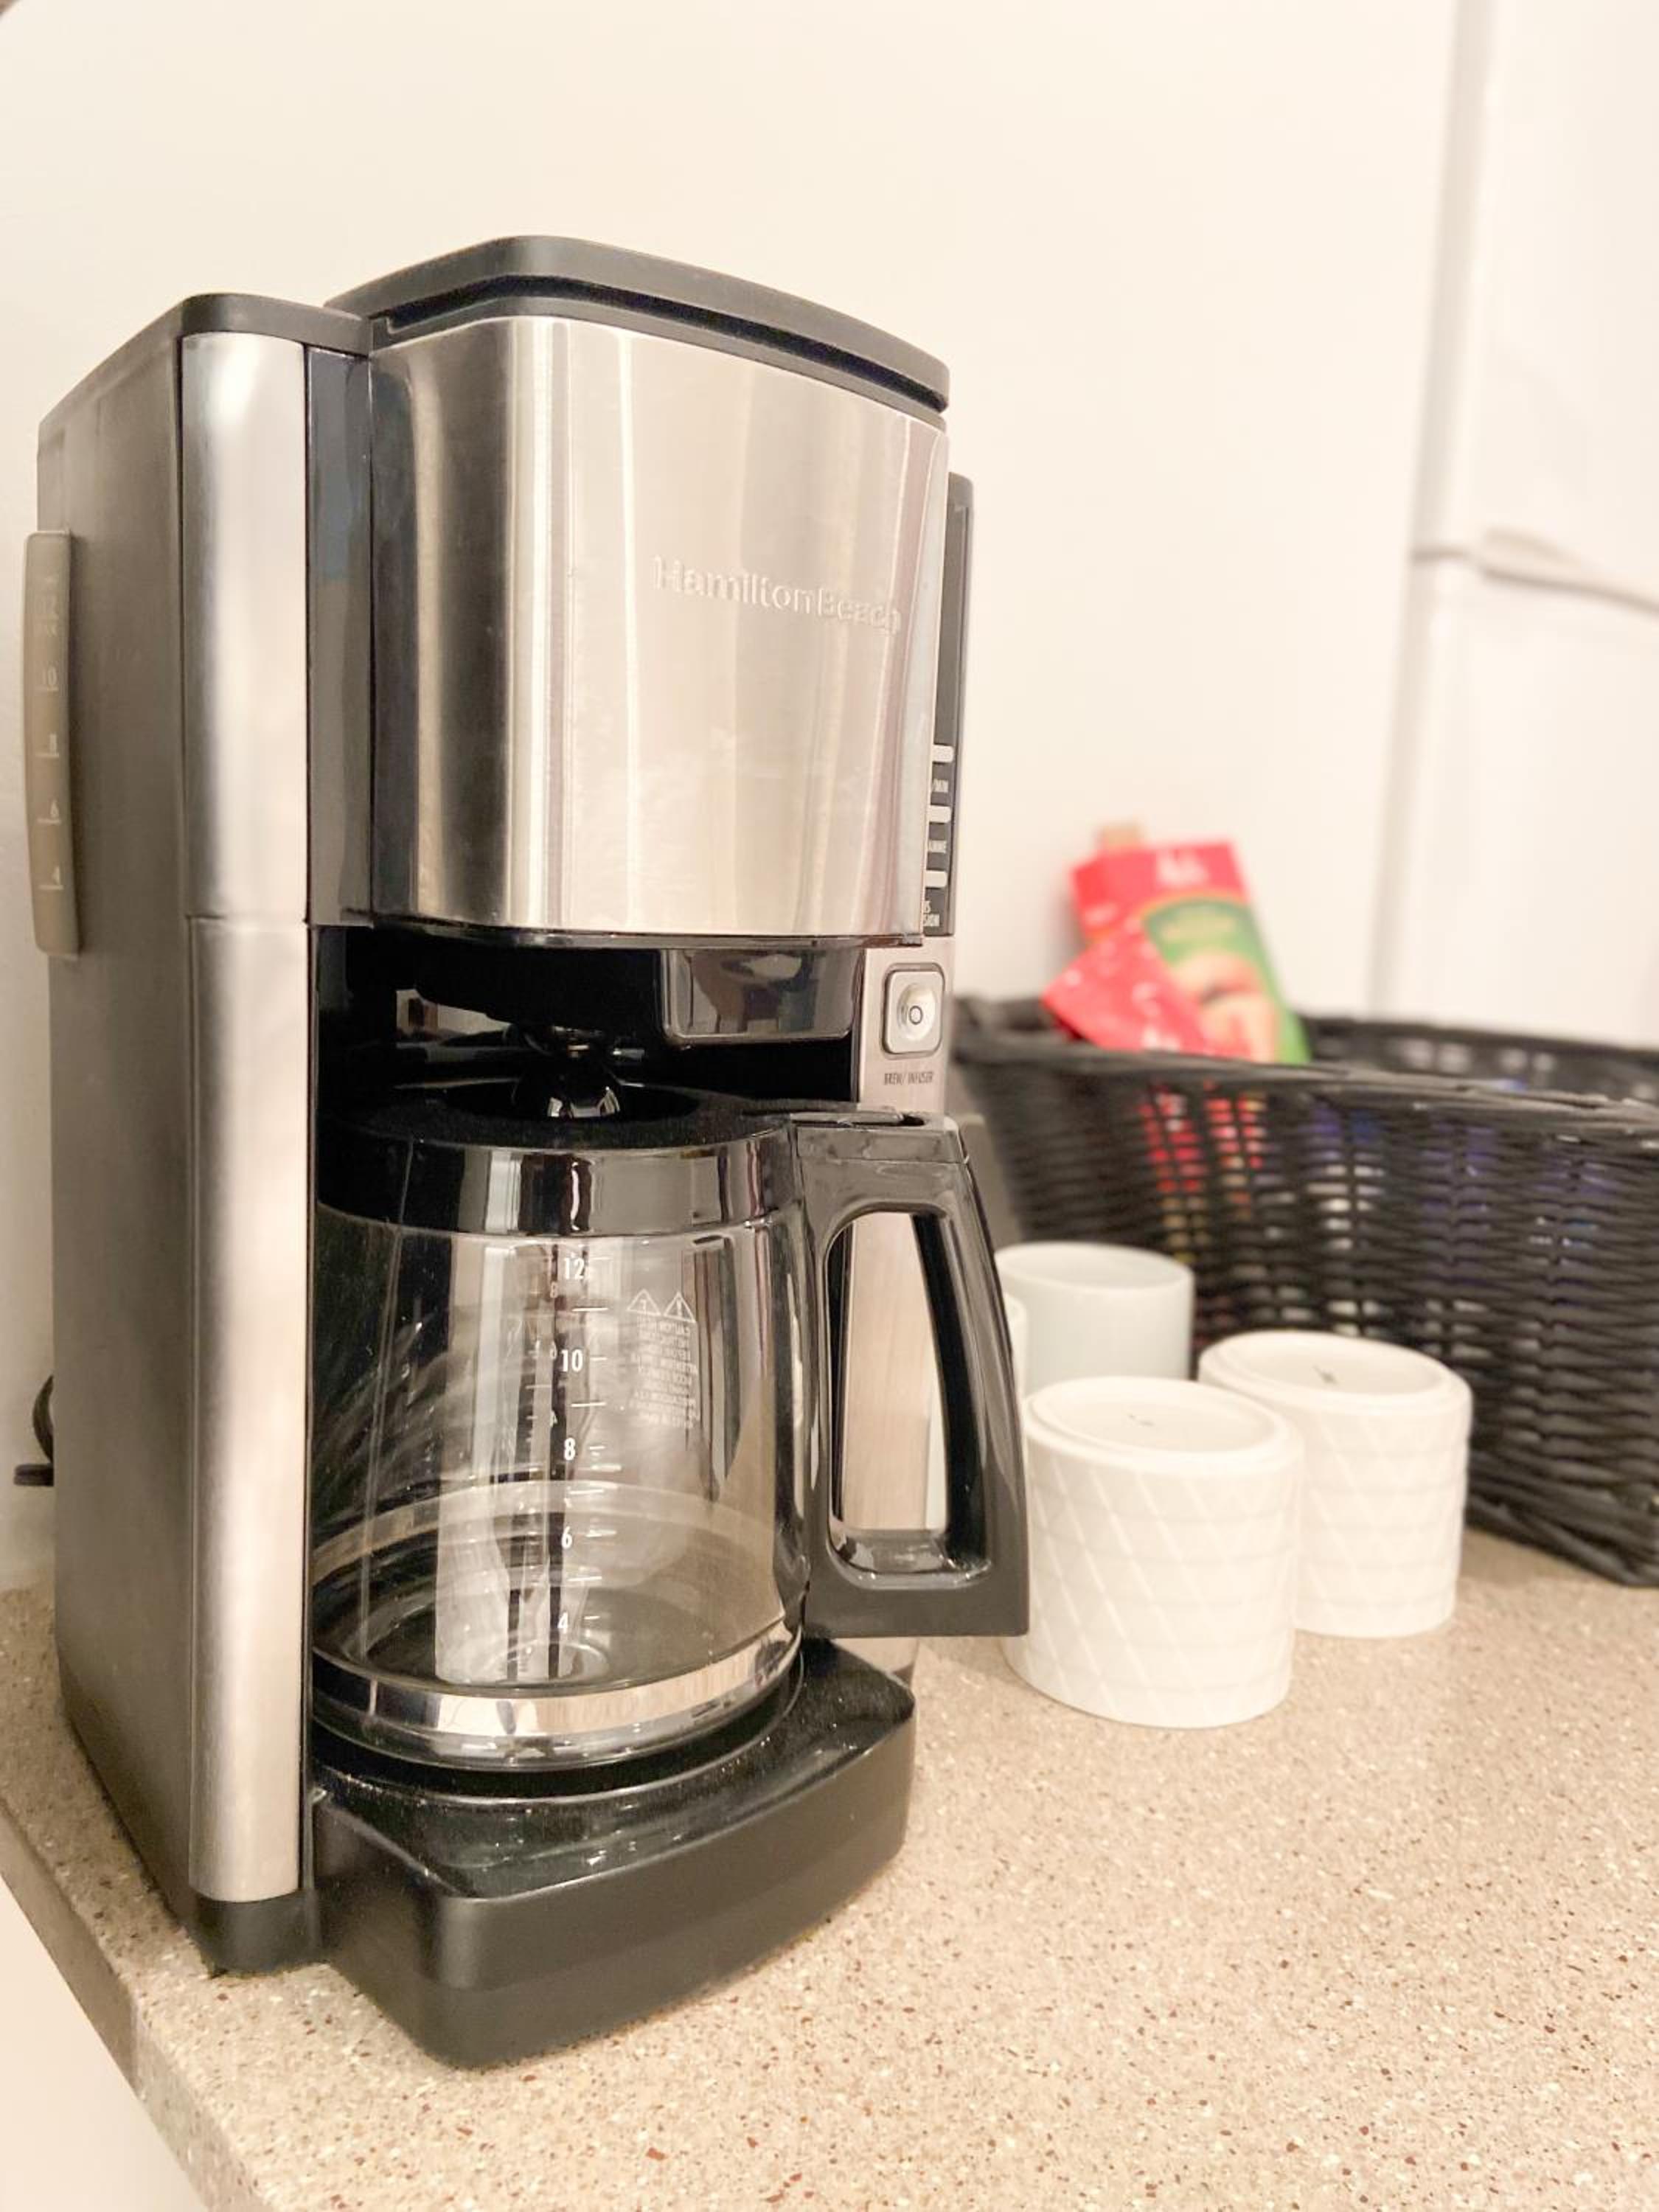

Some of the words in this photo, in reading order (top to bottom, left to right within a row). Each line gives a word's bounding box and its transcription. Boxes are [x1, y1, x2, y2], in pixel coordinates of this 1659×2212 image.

[49, 801, 59, 819] 6
[51, 866, 61, 883] 4
[563, 1257, 585, 1280] 12
[561, 1349, 584, 1372] 10
[563, 1437, 577, 1461] 8
[561, 1526, 573, 1549] 6
[557, 1612, 569, 1634] 4
